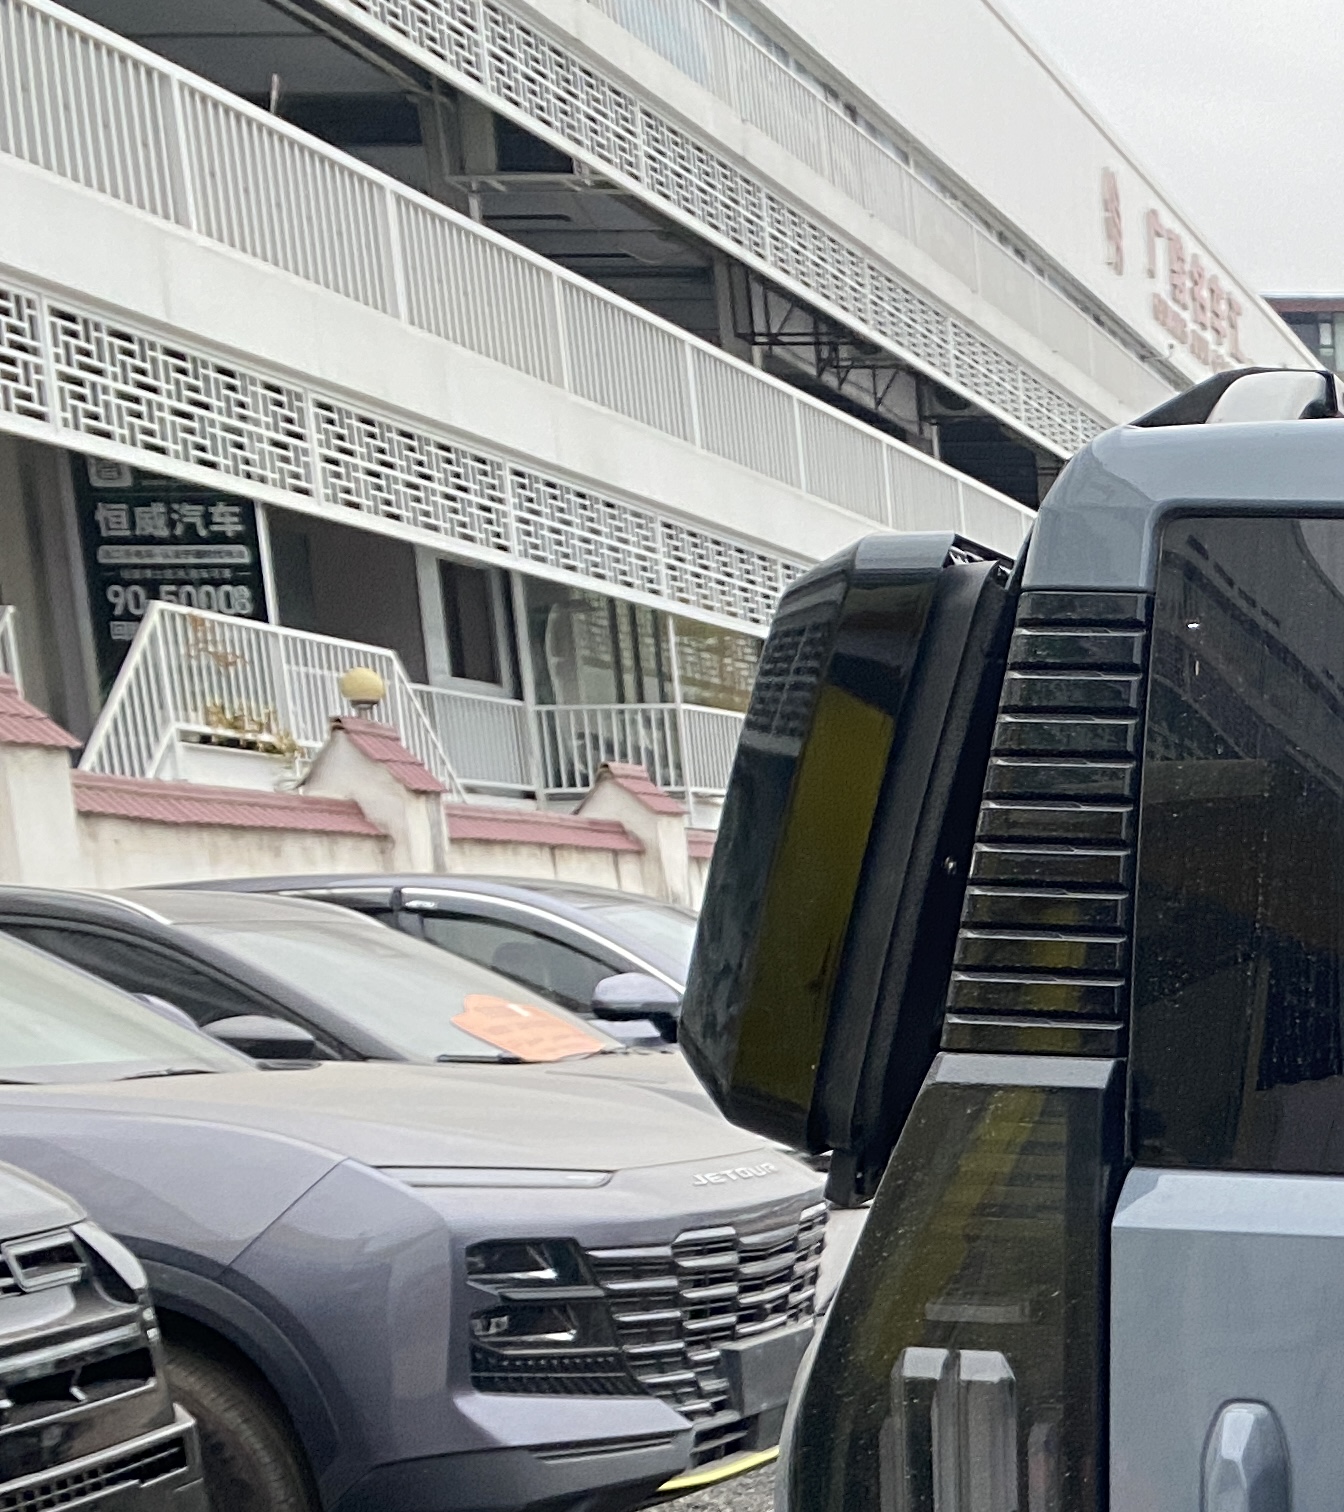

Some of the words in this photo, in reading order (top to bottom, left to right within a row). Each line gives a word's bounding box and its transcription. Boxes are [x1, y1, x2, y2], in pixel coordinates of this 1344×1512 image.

[94, 502, 243, 538] 恒威汽车
[693, 1162, 780, 1187] JETOUR
